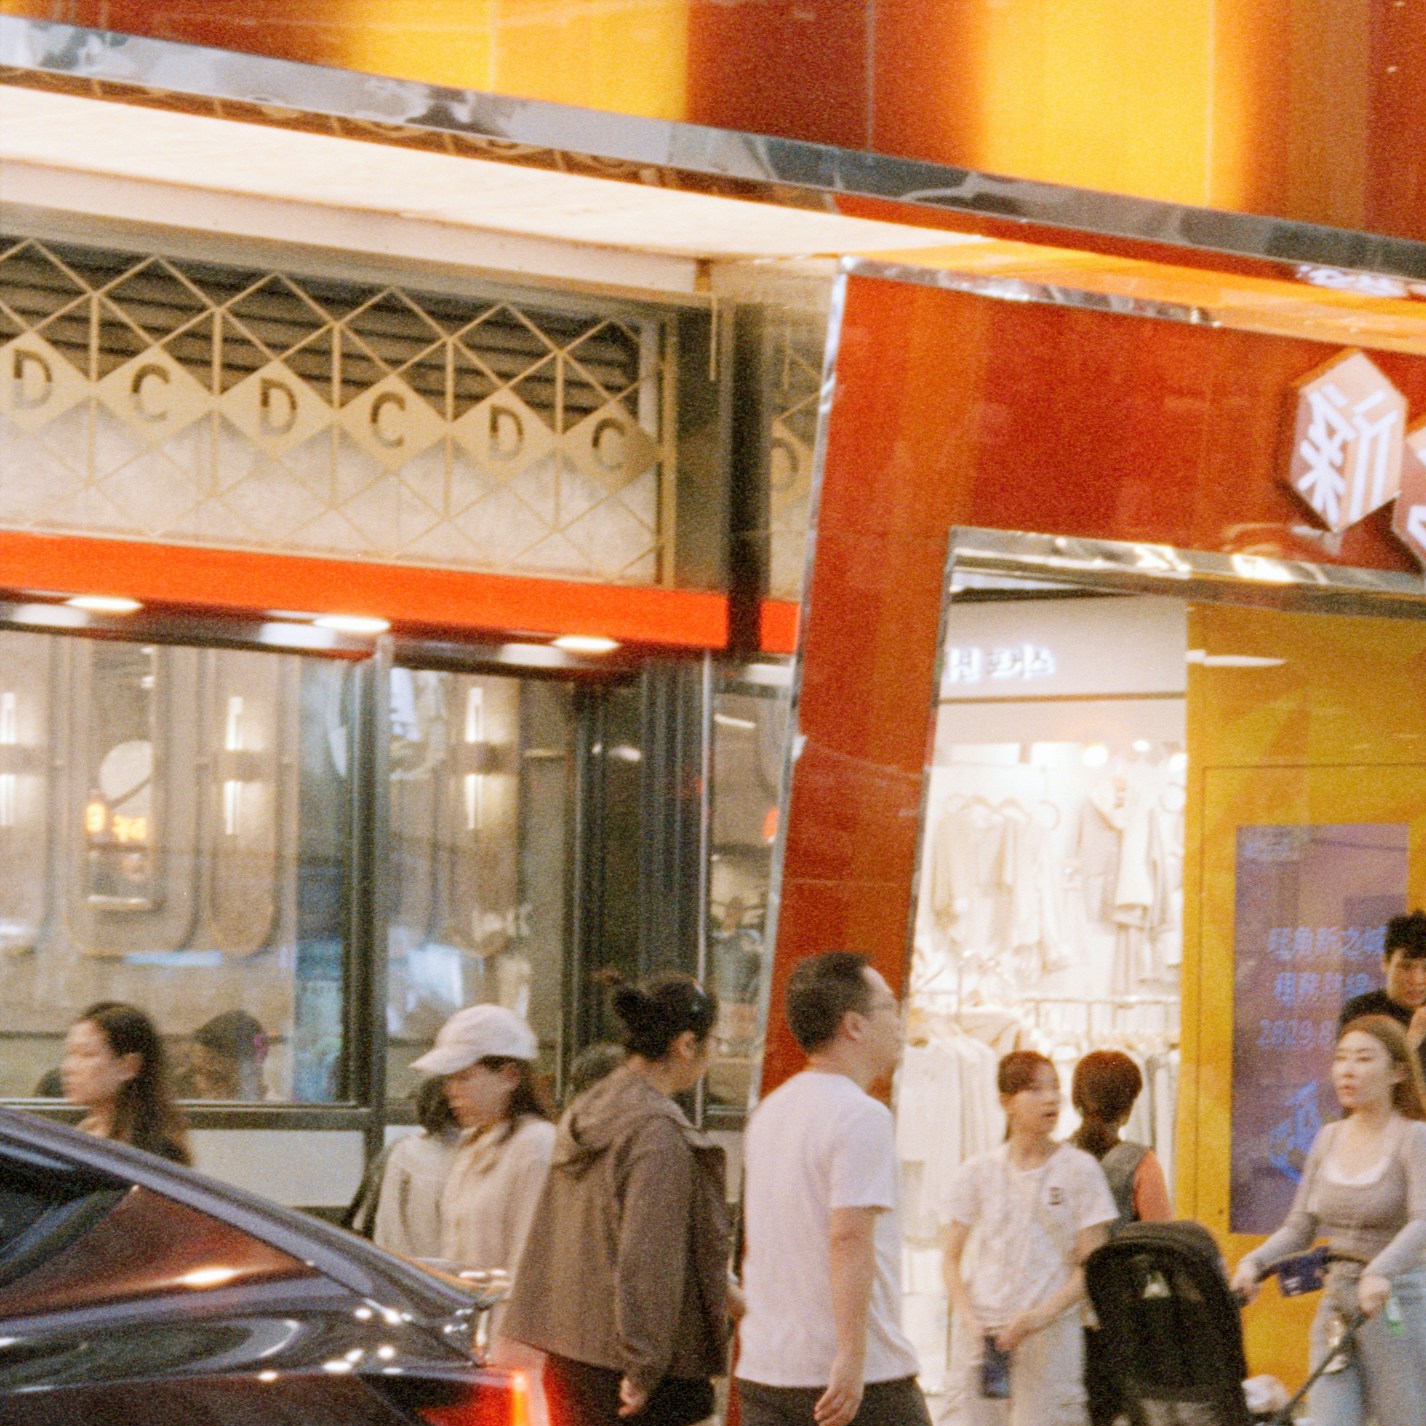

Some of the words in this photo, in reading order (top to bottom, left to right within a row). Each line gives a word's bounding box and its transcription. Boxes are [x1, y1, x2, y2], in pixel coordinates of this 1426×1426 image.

[14, 348, 53, 411] D
[131, 363, 171, 424] C
[260, 378, 298, 437] D
[370, 391, 406, 449] C
[489, 406, 524, 462] D
[591, 417, 625, 472] C
